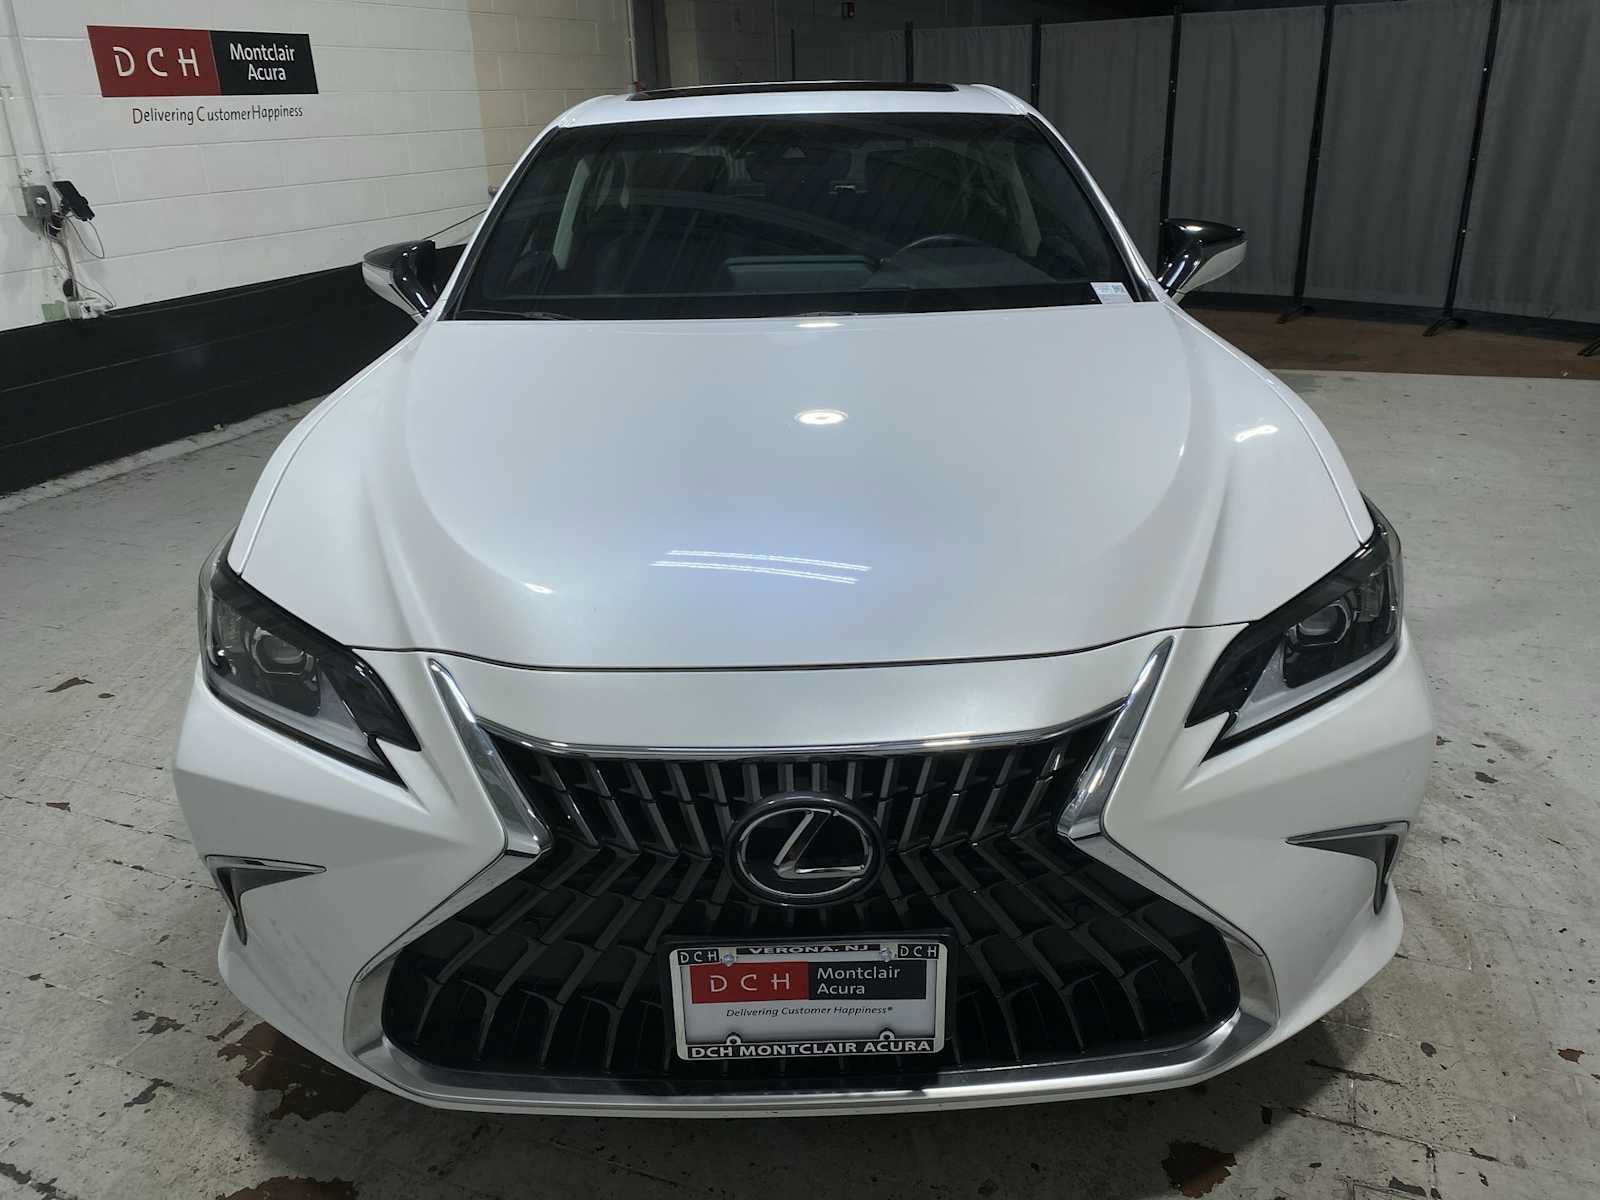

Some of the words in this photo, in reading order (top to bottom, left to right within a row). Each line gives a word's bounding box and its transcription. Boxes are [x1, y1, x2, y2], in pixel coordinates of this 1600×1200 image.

[229, 43, 295, 62] Montclair
[112, 46, 200, 77] DCH
[247, 64, 287, 81] Acura
[132, 107, 194, 125] Delivering
[196, 106, 250, 121] Customer
[251, 105, 303, 121] Happiness
[680, 951, 718, 963] DCH
[900, 945, 938, 957] DCH
[817, 966, 900, 979] Montclair
[709, 973, 790, 993] DCH
[816, 983, 865, 995] Acura
[726, 1006, 779, 1018] Delivering
[781, 1005, 831, 1015] Customer
[692, 1046, 733, 1057] DCH
[740, 1043, 857, 1055] MONTCLAIR
[863, 1041, 931, 1053] ACURA
